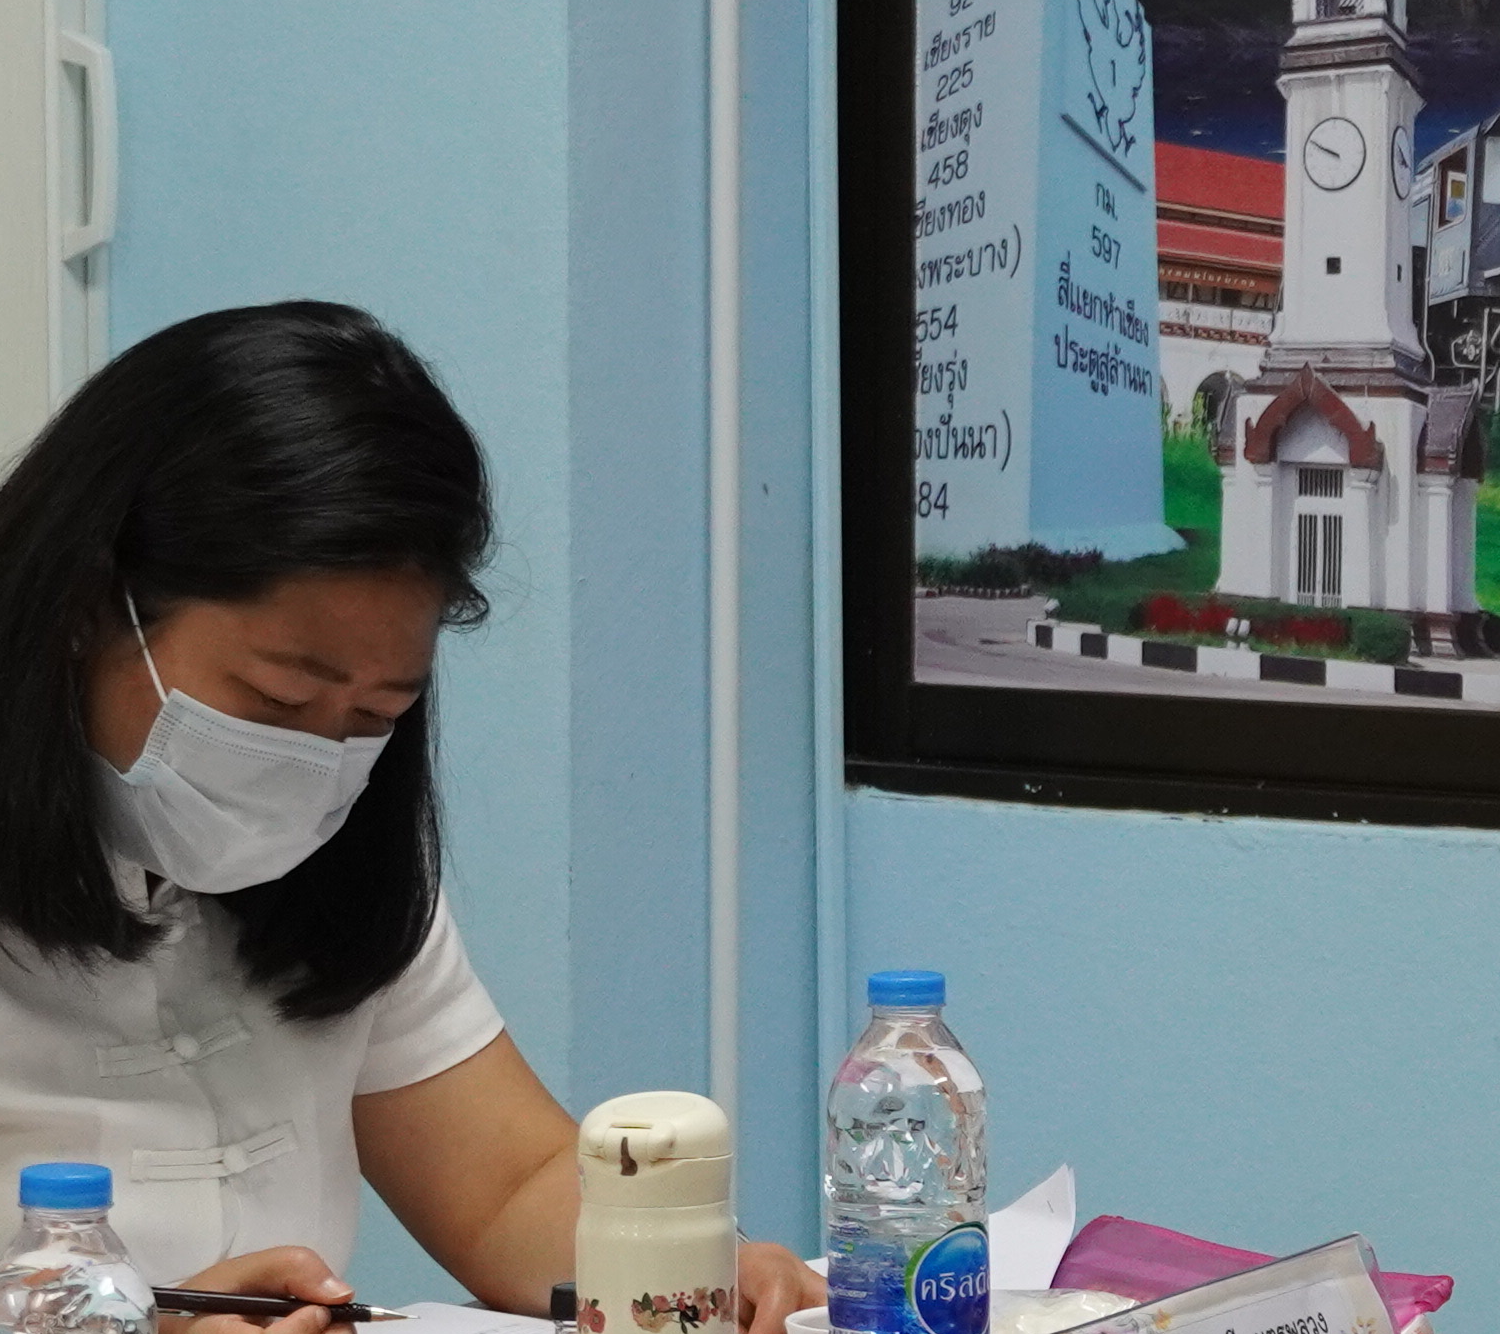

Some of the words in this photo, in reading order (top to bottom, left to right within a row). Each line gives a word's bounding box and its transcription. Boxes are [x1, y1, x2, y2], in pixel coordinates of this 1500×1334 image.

[923, 11, 997, 71] เชียงราย
[935, 59, 974, 103] 225
[920, 102, 983, 153] เชียงตุง
[926, 149, 970, 190] 458
[914, 190, 986, 239] ชียงทอง
[1092, 225, 1121, 270] 597
[1057, 250, 1150, 348] สี่แยกห้าเชียง
[1054, 324, 1153, 397] ประตูสู่ล้านนา
